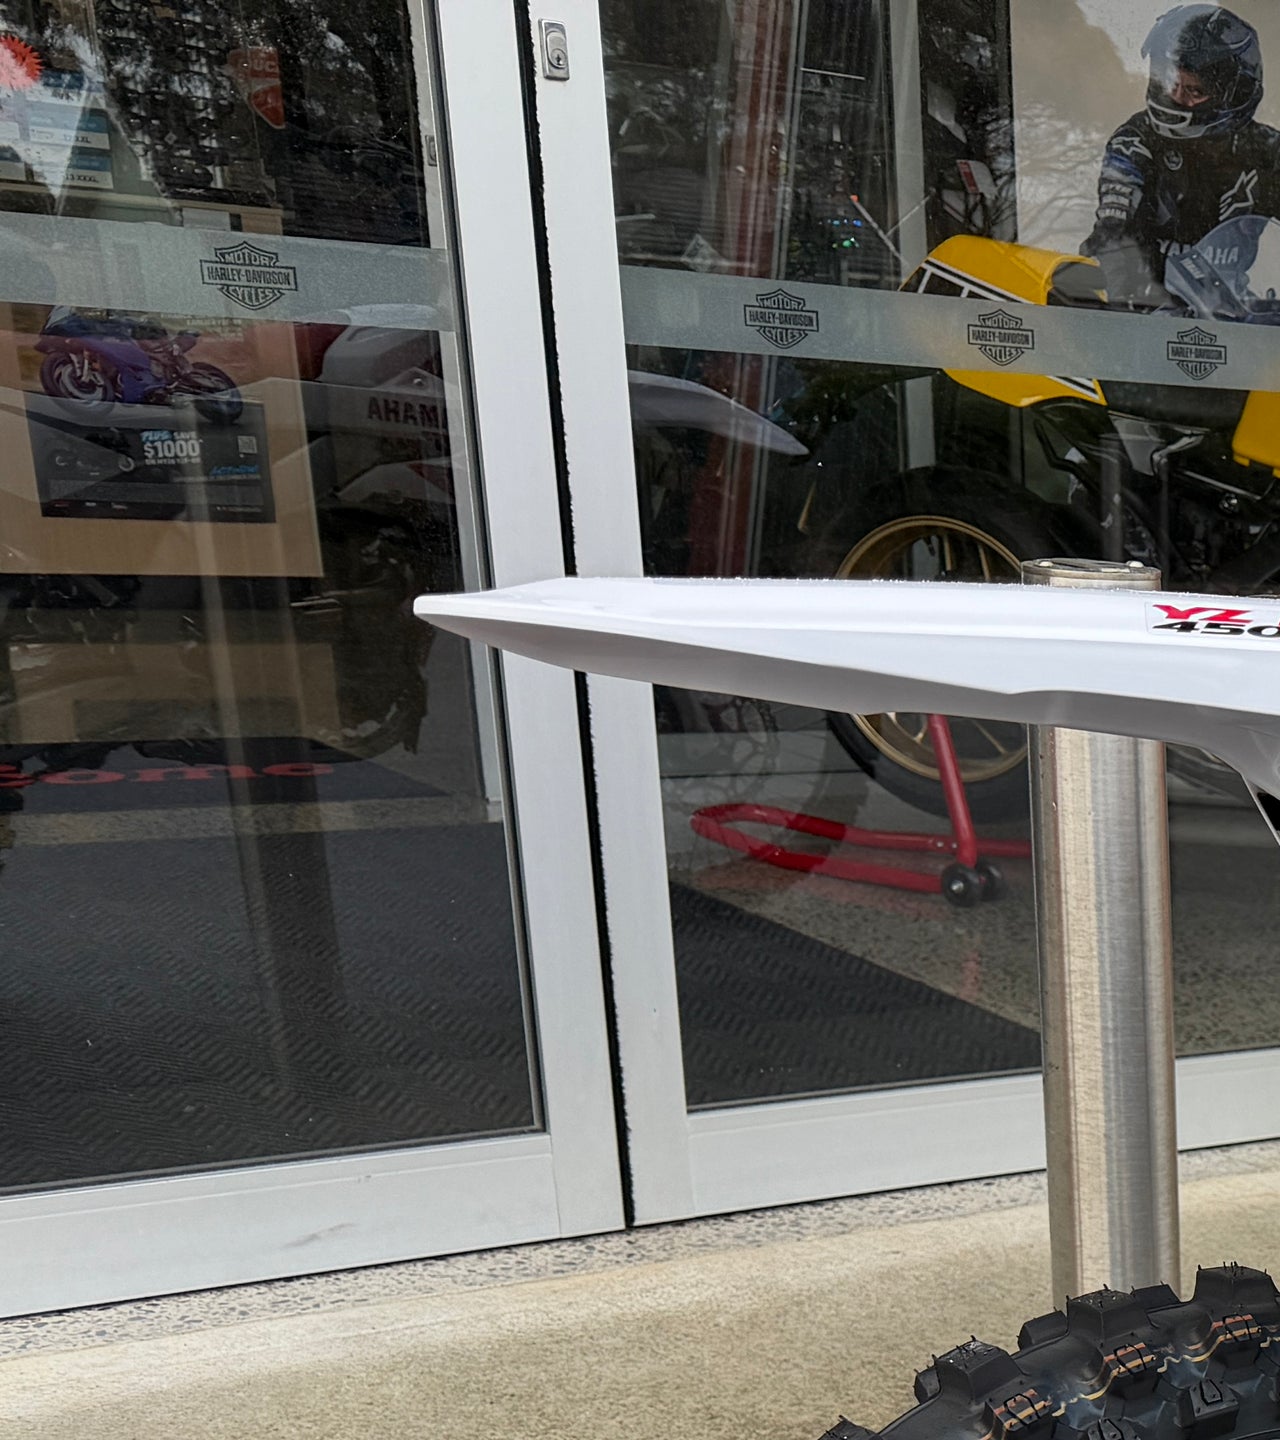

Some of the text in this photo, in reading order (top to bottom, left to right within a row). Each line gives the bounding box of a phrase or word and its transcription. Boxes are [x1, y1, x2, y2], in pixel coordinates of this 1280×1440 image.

[224, 249, 271, 266] MOTOR
[206, 265, 291, 286] HARLEY-DAVIDSON
[227, 285, 275, 304] CYCLES
